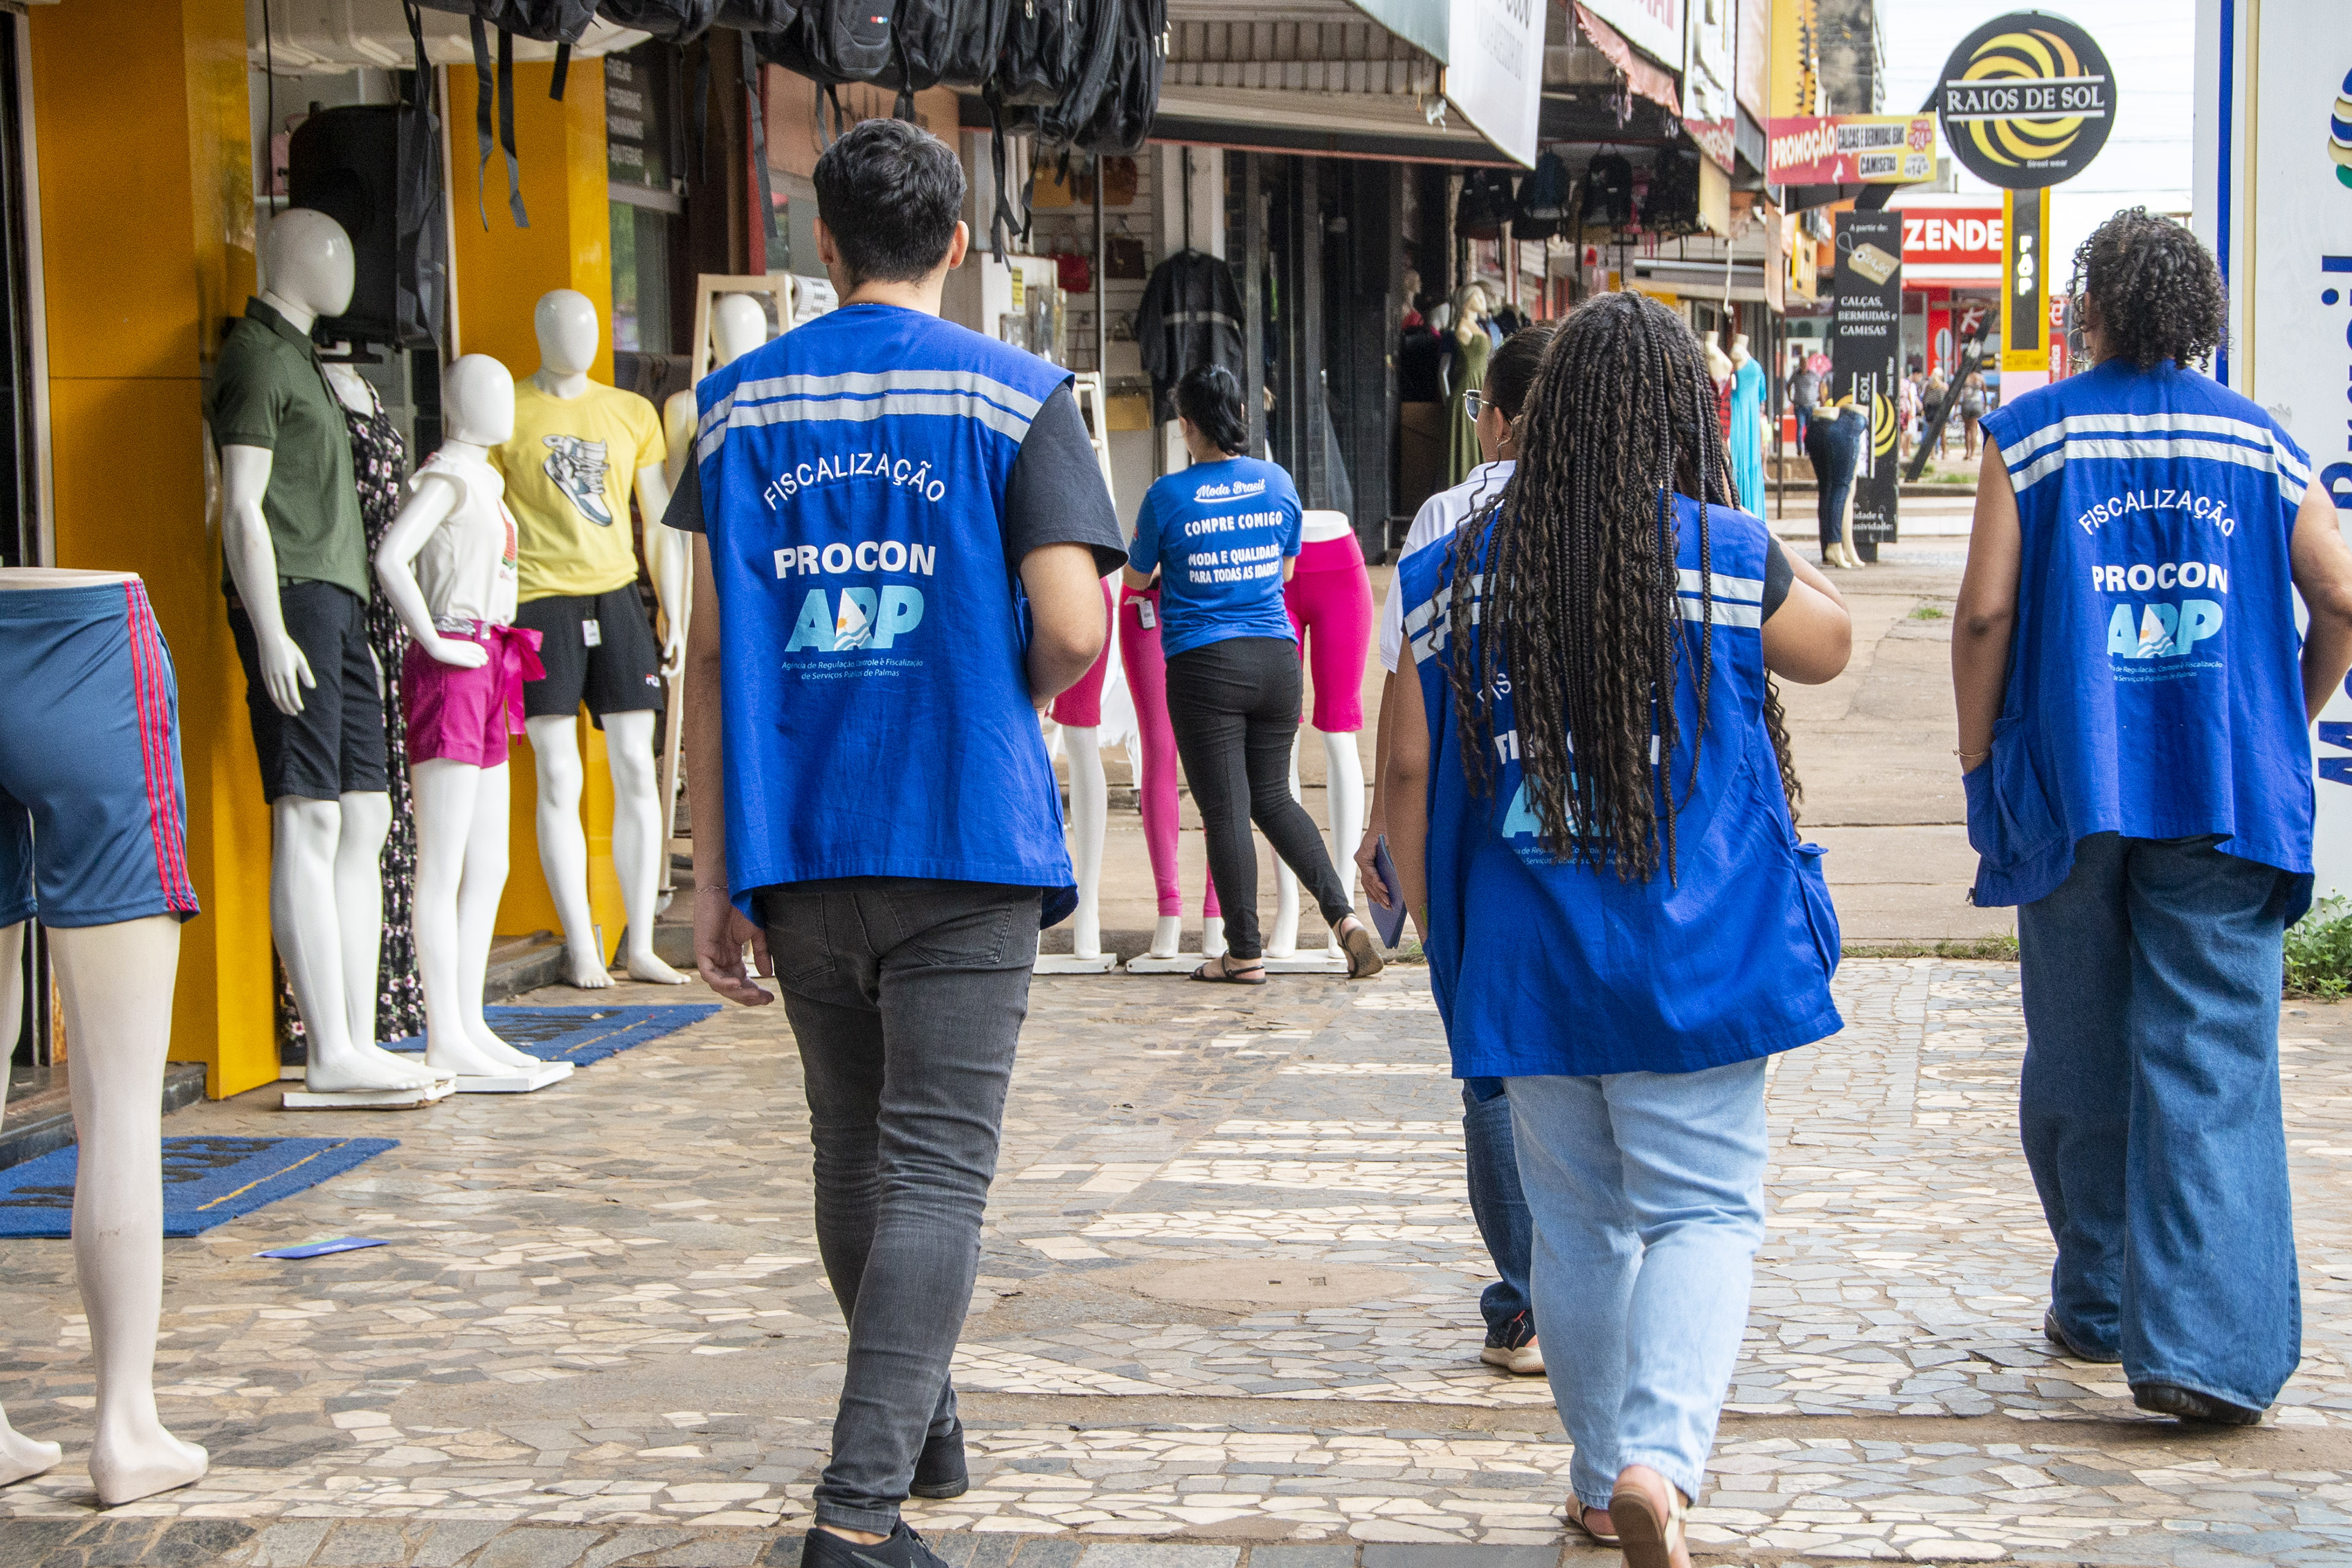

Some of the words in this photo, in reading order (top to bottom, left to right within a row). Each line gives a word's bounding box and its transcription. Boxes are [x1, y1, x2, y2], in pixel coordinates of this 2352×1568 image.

[1947, 88, 2019, 112] RAIOS
[2025, 87, 2056, 110] DE
[2061, 85, 2105, 109] SOL
[1771, 119, 1836, 170] PROMOÇÃO
[2026, 159, 2049, 168] Street
[1838, 311, 1890, 322] BERMUDAS
[1891, 312, 1898, 321] e
[1840, 325, 1887, 336] CAMISAS
[1860, 372, 1870, 402] SOL
[763, 452, 945, 511] FISCALIZAÇÃO
[1196, 483, 1231, 499] Moda
[1232, 478, 1266, 494] Brasil
[1184, 516, 1235, 537] COMPRE
[1237, 510, 1283, 530] COMIGO
[2078, 488, 2235, 537] FISCALIZAÇÃO
[773, 540, 937, 579] PROCON
[1188, 552, 1219, 566] MODA
[1220, 550, 1228, 564] E
[1230, 543, 1280, 565] QUALIDADE
[1189, 569, 1212, 583] PARA
[1213, 567, 1242, 582] TODAS
[1243, 565, 1254, 580] AS
[2091, 562, 2228, 594] PROCON
[807, 661, 817, 669] de
[885, 658, 924, 668] Fiscalização
[812, 672, 843, 680] Serviços
[864, 668, 873, 677] de
[874, 668, 900, 677] Palmas
